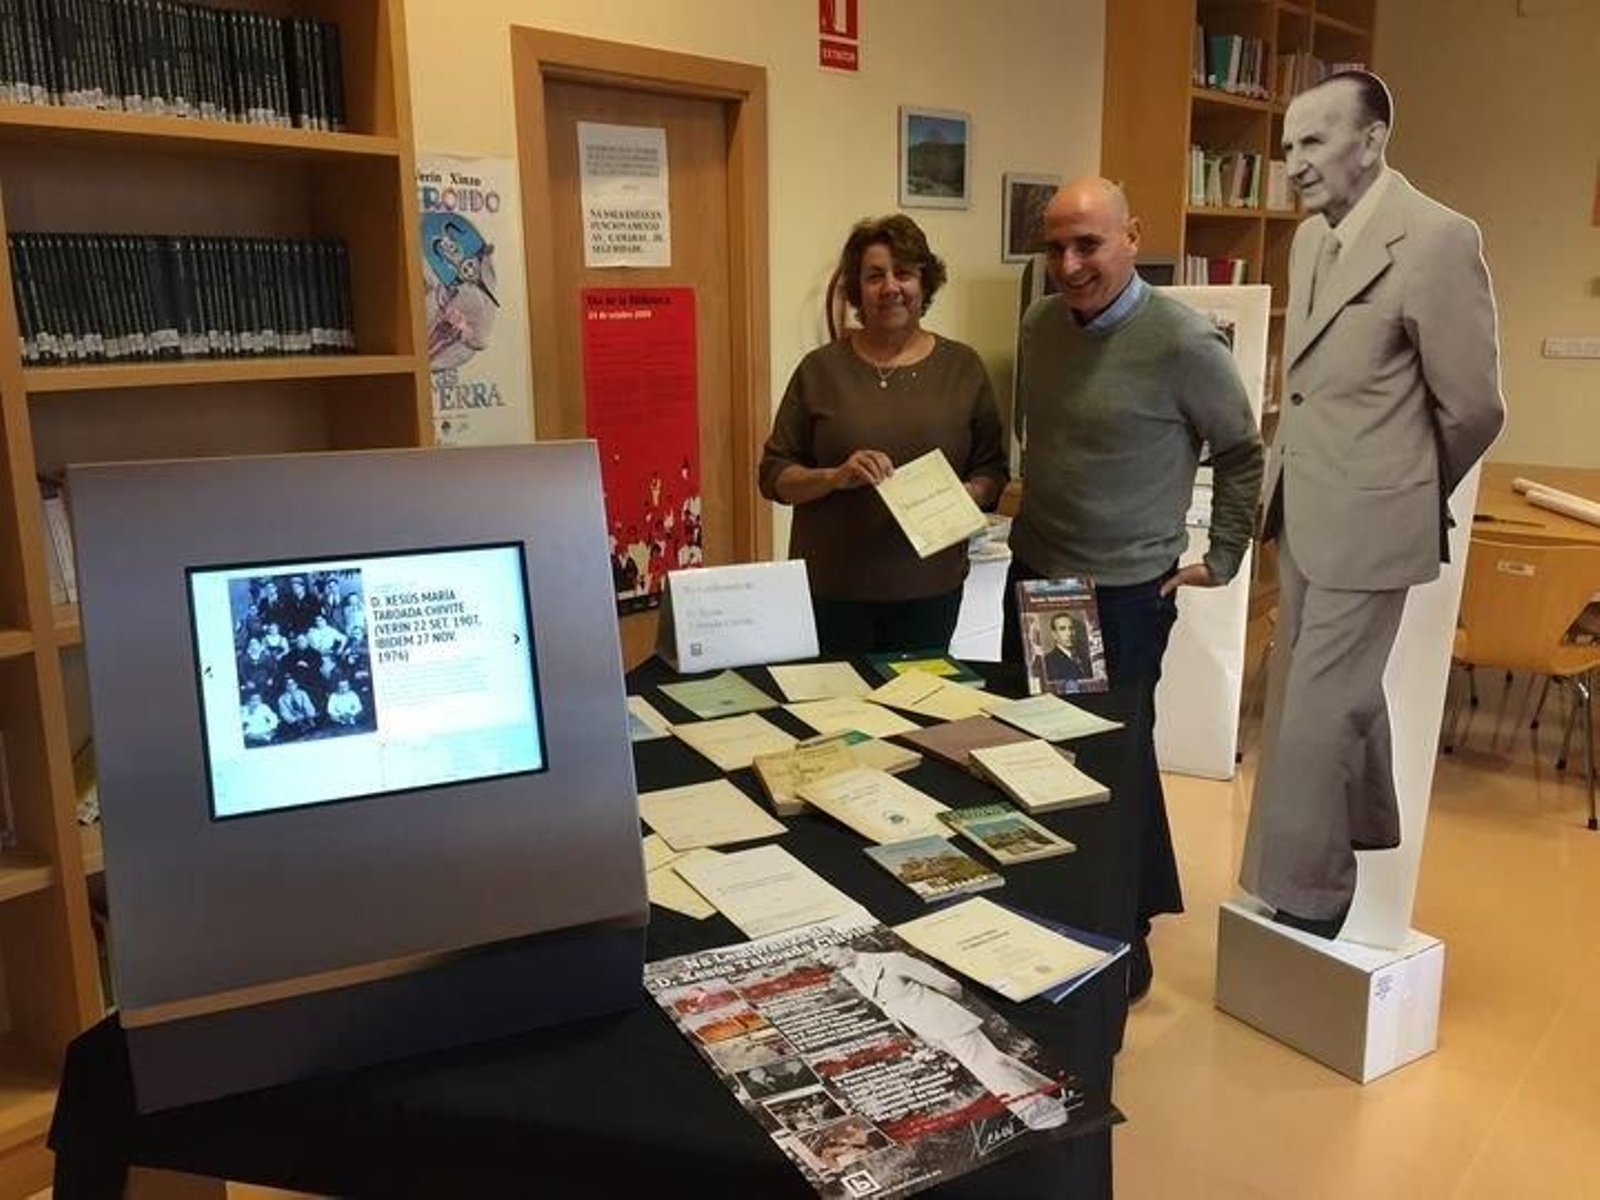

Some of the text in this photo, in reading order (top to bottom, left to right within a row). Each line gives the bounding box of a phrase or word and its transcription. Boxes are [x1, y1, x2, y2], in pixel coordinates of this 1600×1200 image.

[415, 173, 442, 182] erin
[422, 186, 500, 213] ROIDO
[438, 383, 506, 411] ERRA
[373, 603, 465, 621] TABOADA CHIVITE
[414, 619, 427, 632] 22
